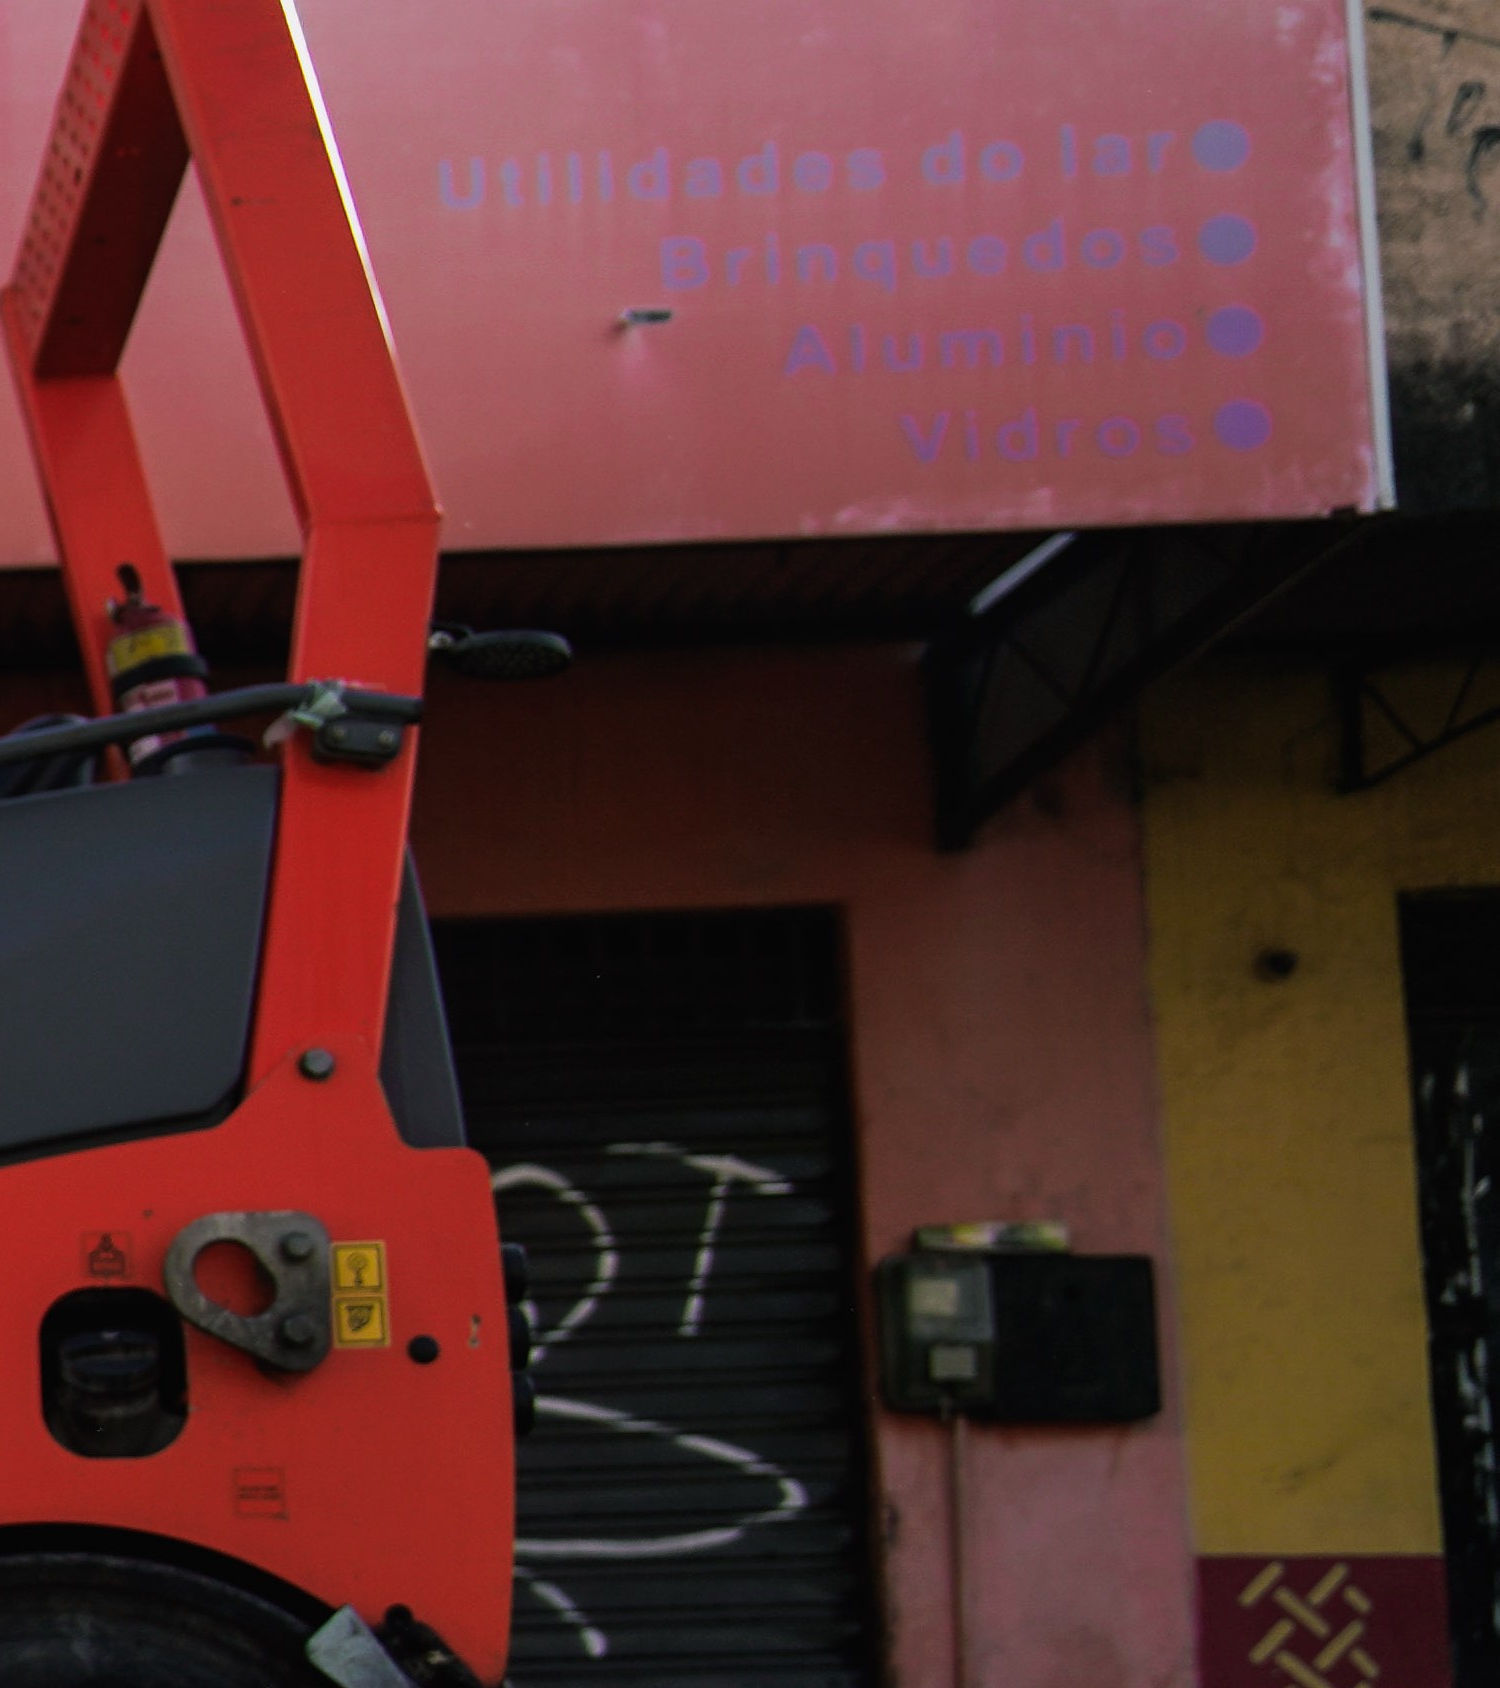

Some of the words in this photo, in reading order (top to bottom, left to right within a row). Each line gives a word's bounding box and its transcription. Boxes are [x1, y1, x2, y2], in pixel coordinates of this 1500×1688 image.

[437, 140, 886, 210] Utilidades
[921, 130, 1025, 187] do
[1059, 123, 1178, 180] lar
[658, 214, 1182, 294] Brinquedos
[900, 404, 1197, 464] Vidros
